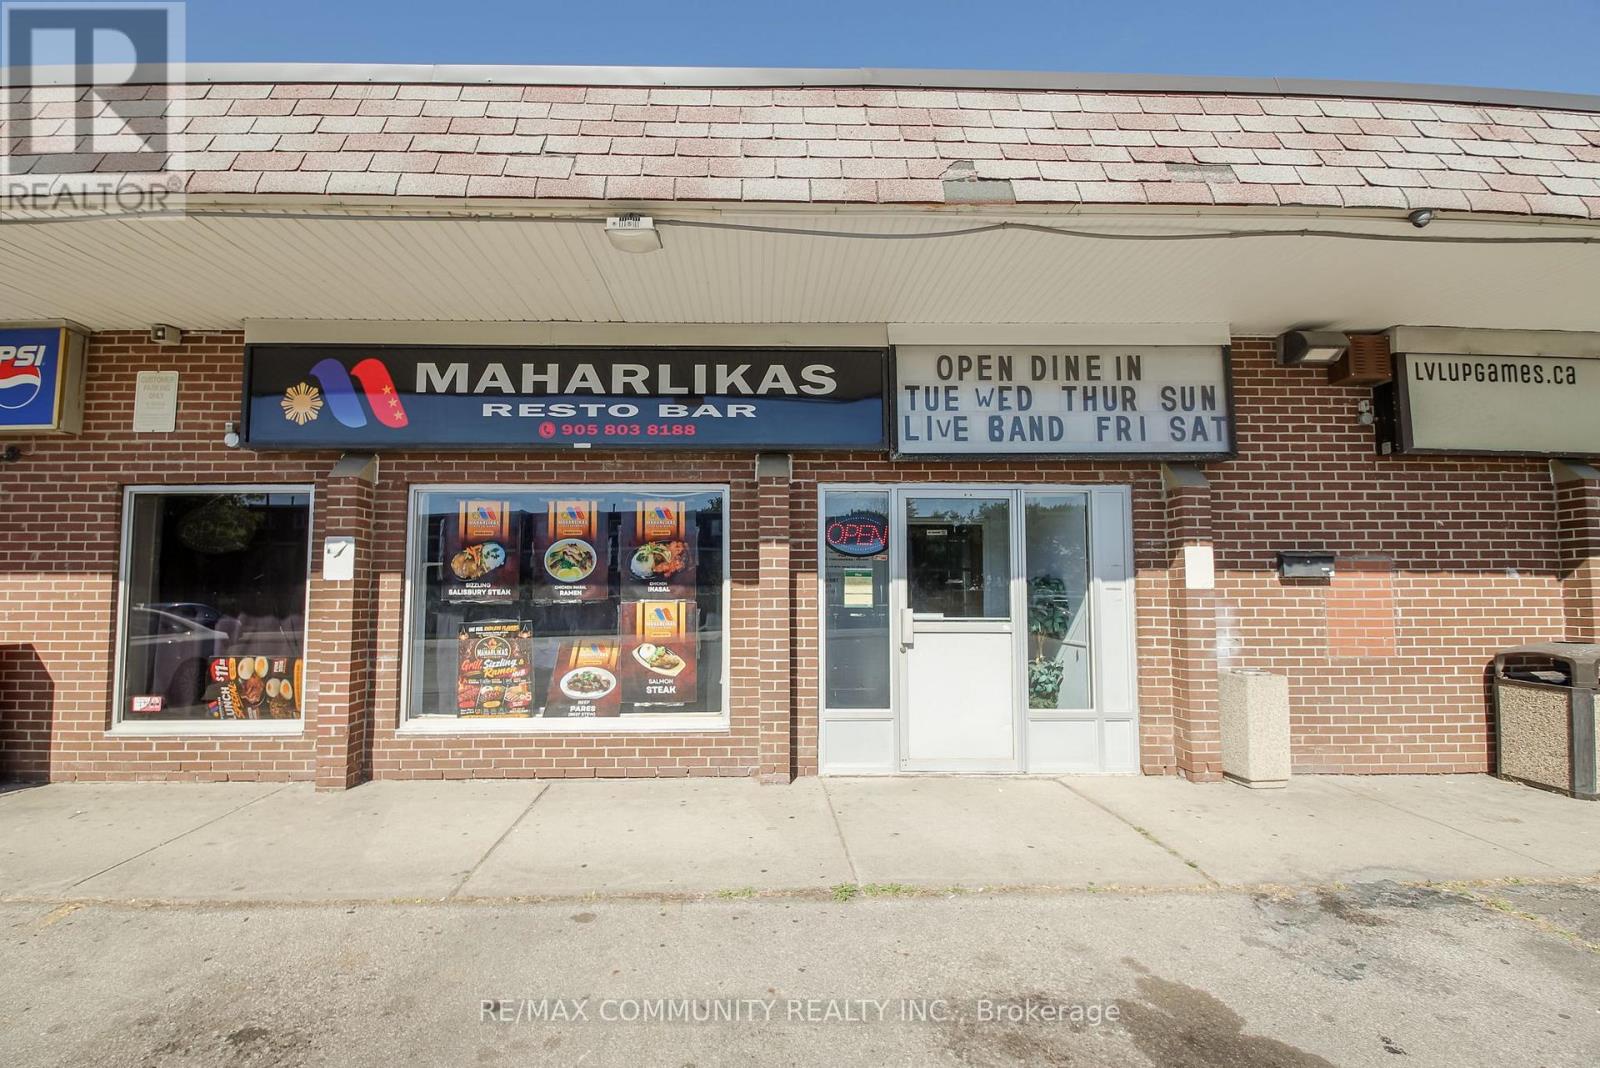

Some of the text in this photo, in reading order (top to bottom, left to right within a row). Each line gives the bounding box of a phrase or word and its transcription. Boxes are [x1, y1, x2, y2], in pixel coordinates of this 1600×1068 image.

[415, 362, 838, 396] MAHARLIKAS
[936, 354, 1142, 381] OPEN DINE IN
[481, 403, 757, 418] RESTO BAR
[904, 385, 1216, 412] TUE WED THUR SUN
[561, 424, 696, 436] 905 803 8188
[904, 415, 1227, 442] LIVE BAND FRI SAT
[826, 522, 889, 546] OPEN
[646, 686, 677, 694] STEAK
